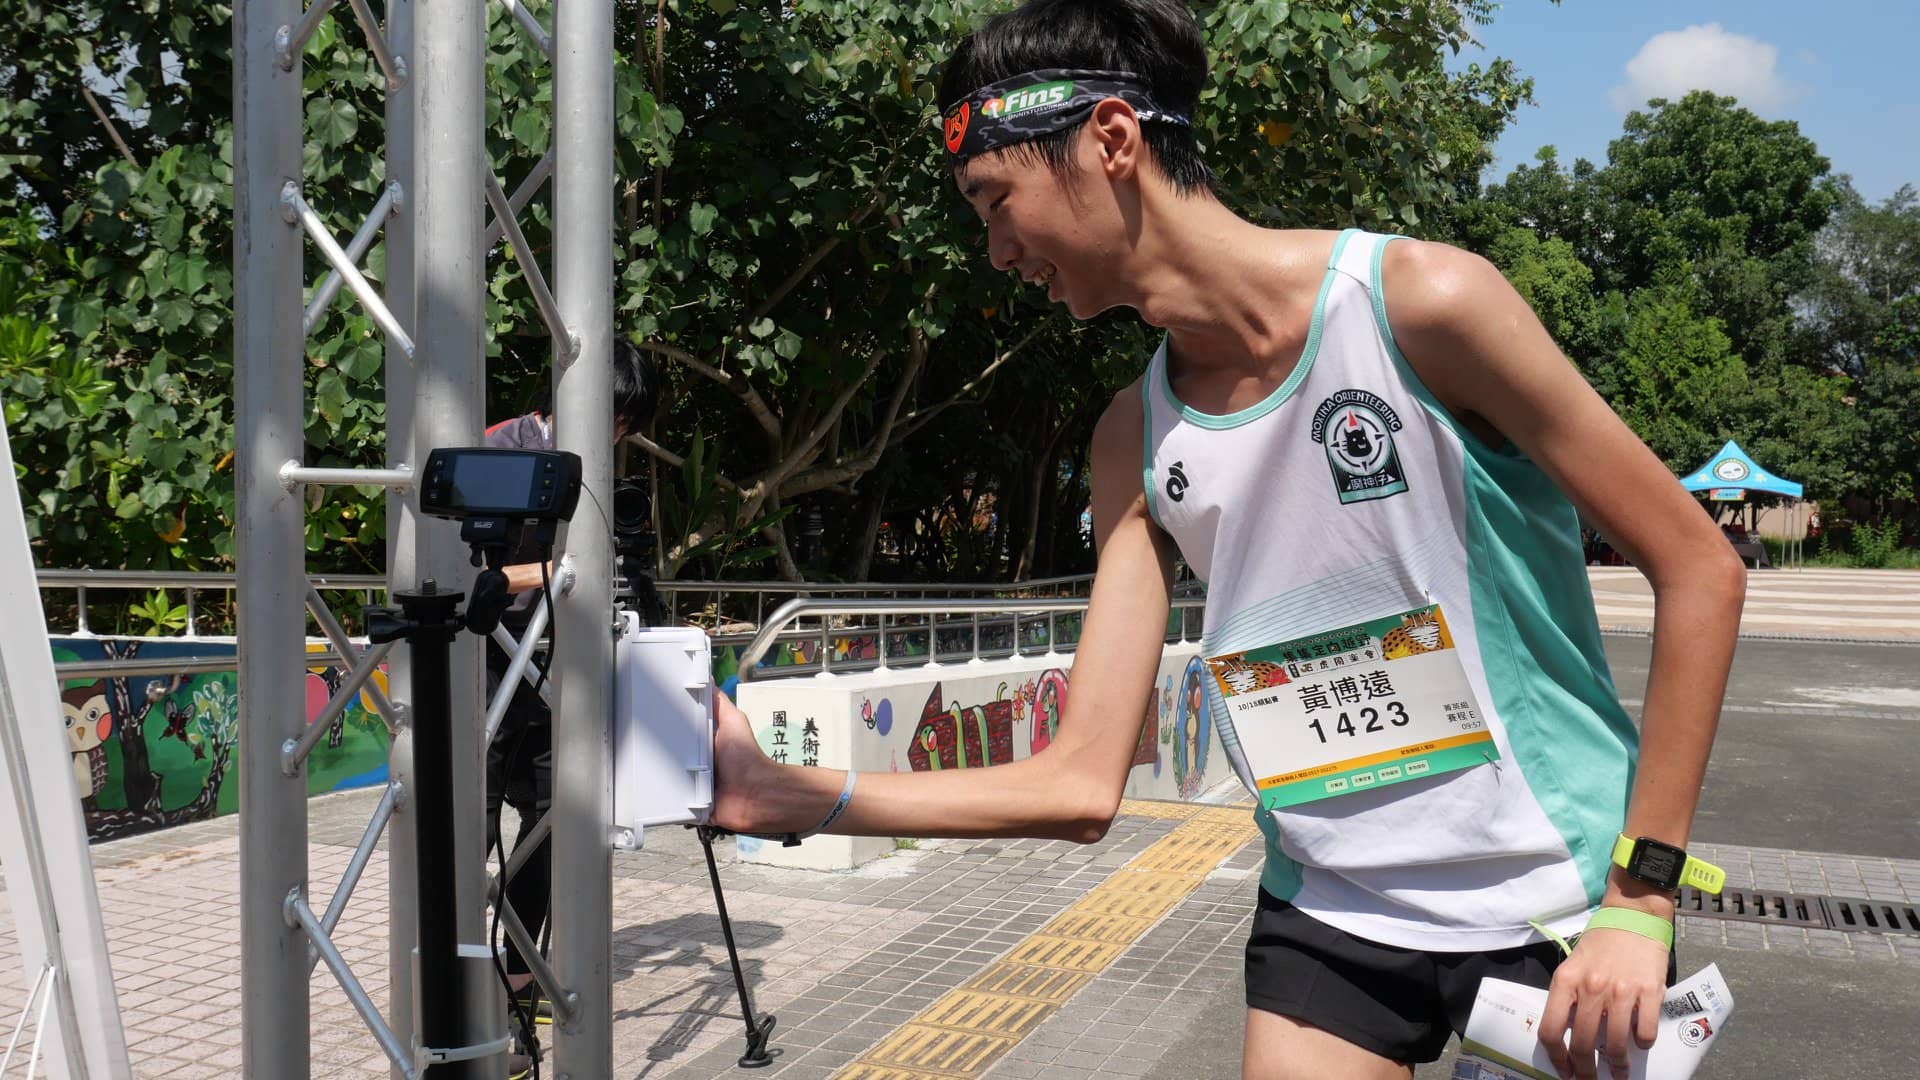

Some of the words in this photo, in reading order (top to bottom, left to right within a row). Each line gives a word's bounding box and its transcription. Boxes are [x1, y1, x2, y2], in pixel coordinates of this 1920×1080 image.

[1005, 85, 1065, 112] Fin5
[1313, 399, 1335, 443] MOXINA
[1335, 391, 1402, 432] ORIENTEERING
[1297, 669, 1396, 714] 黃博遠
[771, 710, 790, 765] 國立竹
[1309, 701, 1410, 744] 1423
[1446, 711, 1468, 723] 賽程
[1469, 709, 1477, 719] E
